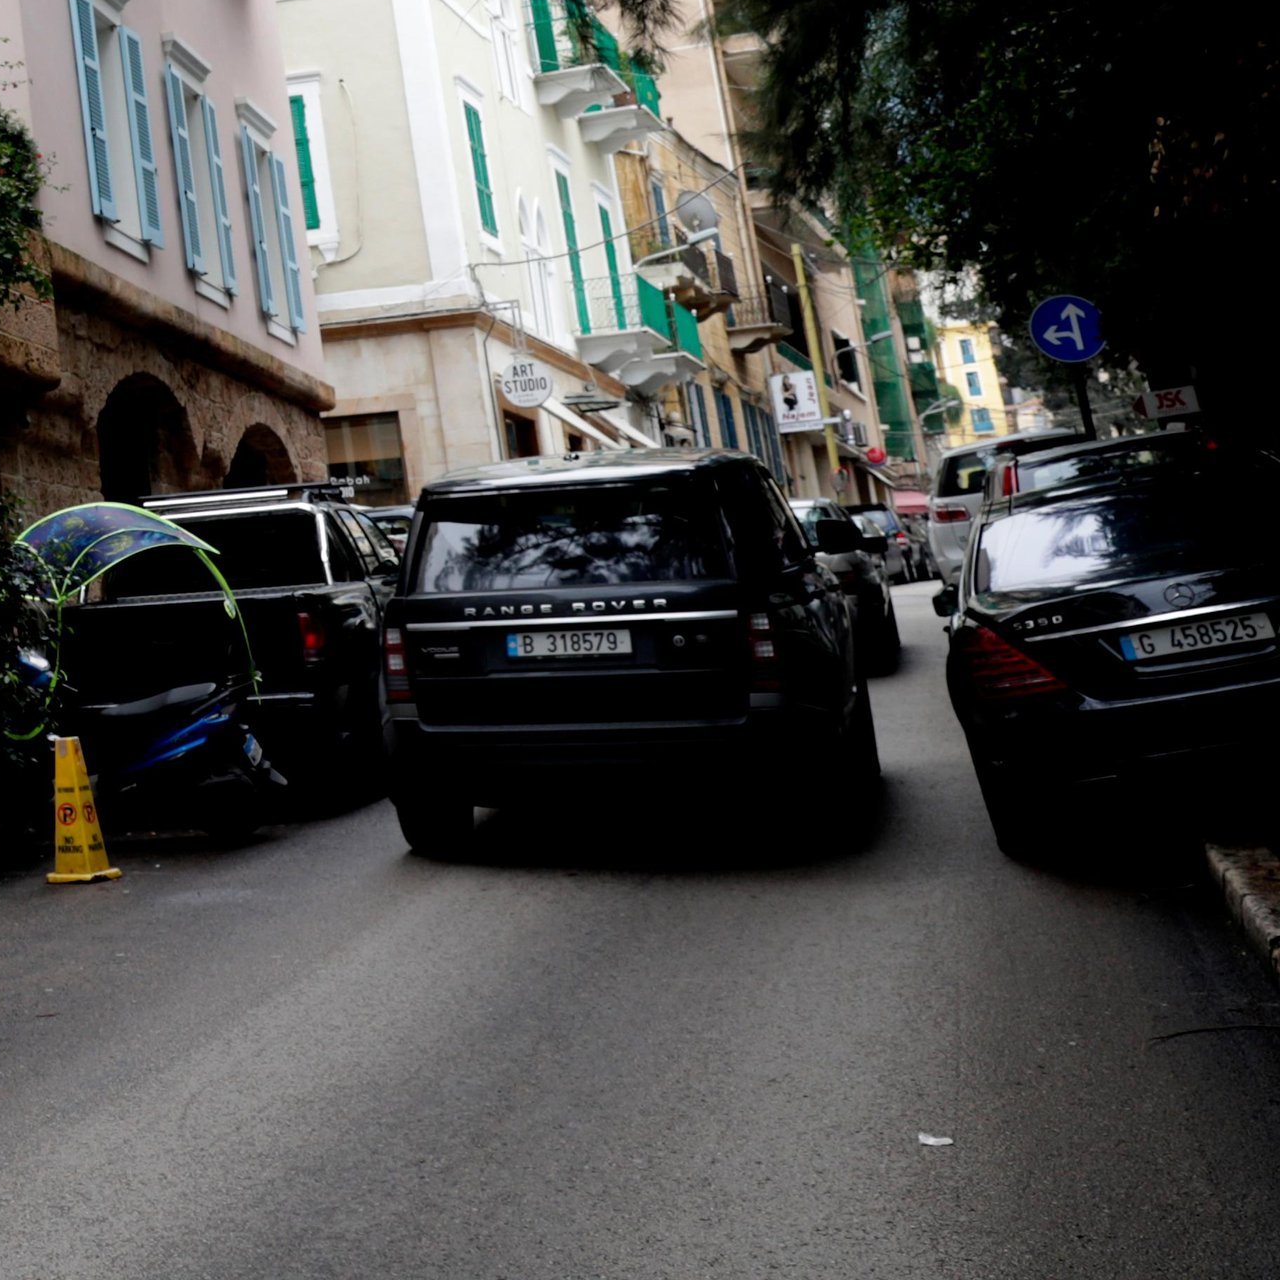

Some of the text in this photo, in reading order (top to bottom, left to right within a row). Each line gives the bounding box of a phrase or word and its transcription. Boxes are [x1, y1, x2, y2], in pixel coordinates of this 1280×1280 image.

[512, 363, 534, 379] ART
[504, 376, 547, 394] STUDIO
[464, 598, 668, 616] RANGE ROVER
[522, 631, 618, 654] B 318579
[1139, 619, 1258, 655] G 458525
